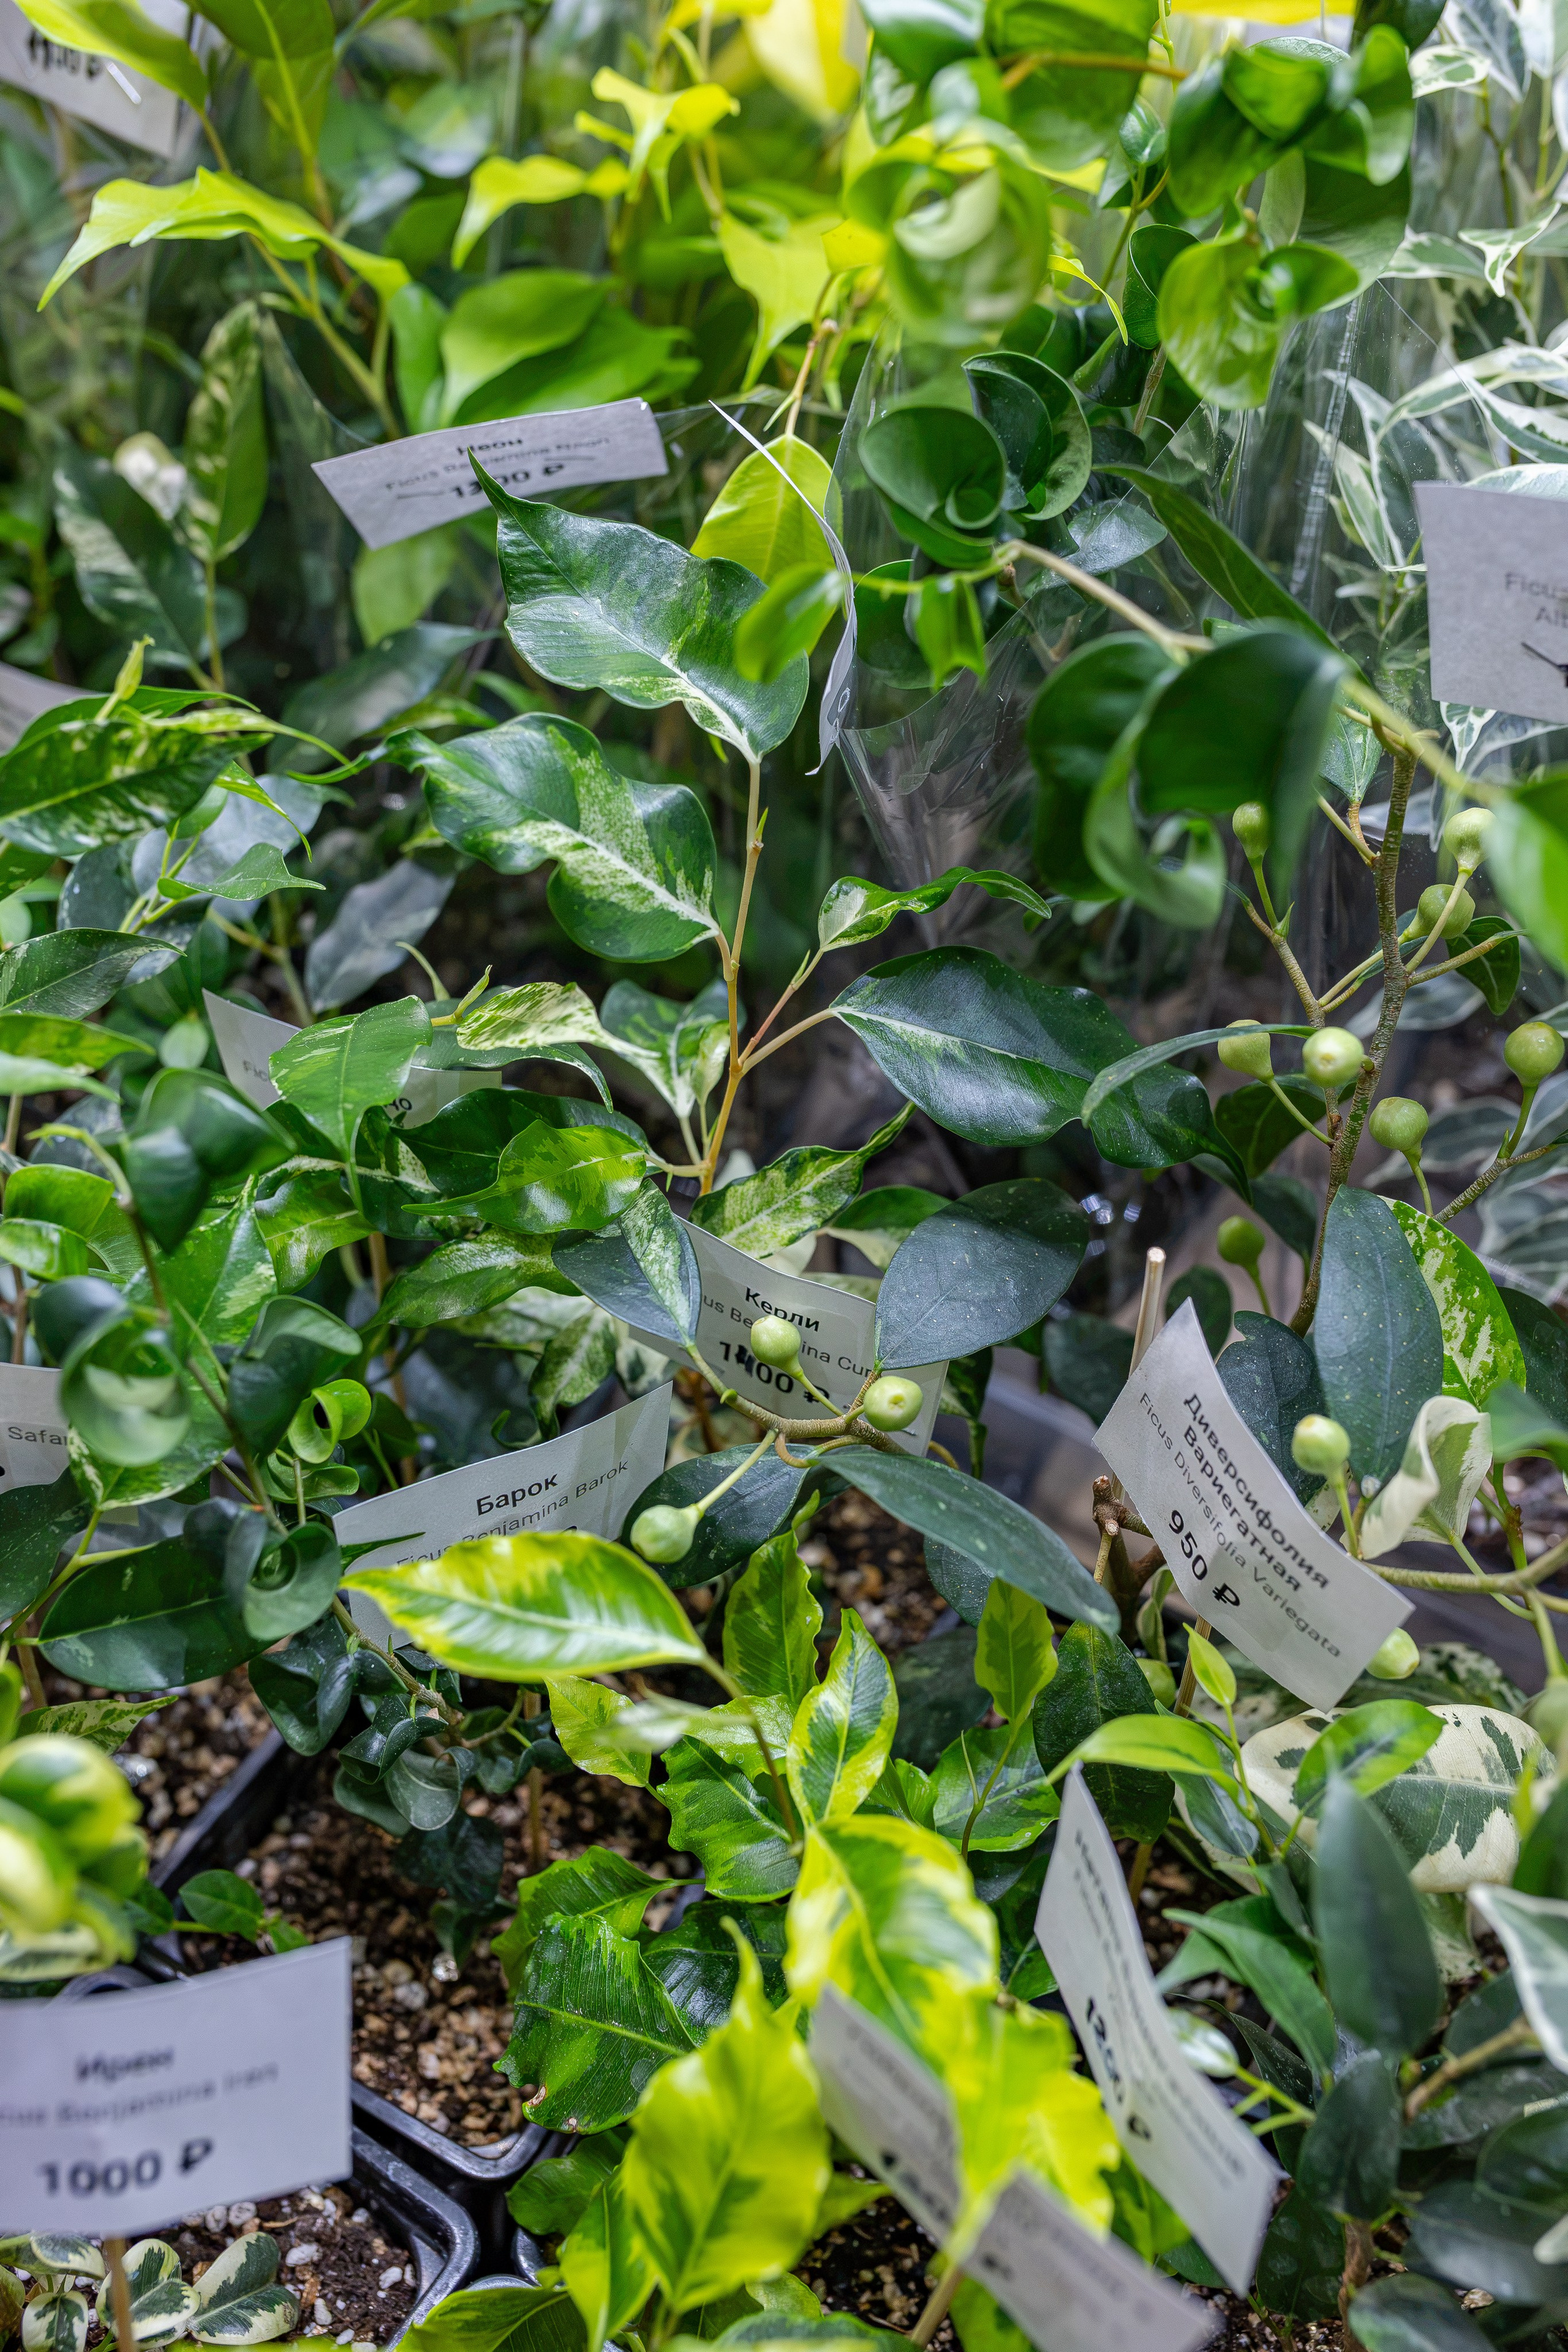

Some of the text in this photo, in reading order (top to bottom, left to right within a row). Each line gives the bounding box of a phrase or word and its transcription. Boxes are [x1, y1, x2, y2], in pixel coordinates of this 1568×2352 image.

[243, 1060, 268, 1083] Fic
[731, 1306, 831, 1363] Beina
[745, 1286, 820, 1332] Керли
[476, 1473, 559, 1517] Барок
[575, 1460, 628, 1499] Barok
[1183, 1393, 1329, 1589] Диверсифолия
[1140, 1392, 1341, 1658] Ficus Diversifolia Variegata
[1183, 1425, 1302, 1593] Вариегатная
[1168, 1509, 1240, 1607] 950 ₽
[37, 2148, 162, 2199] 1000
